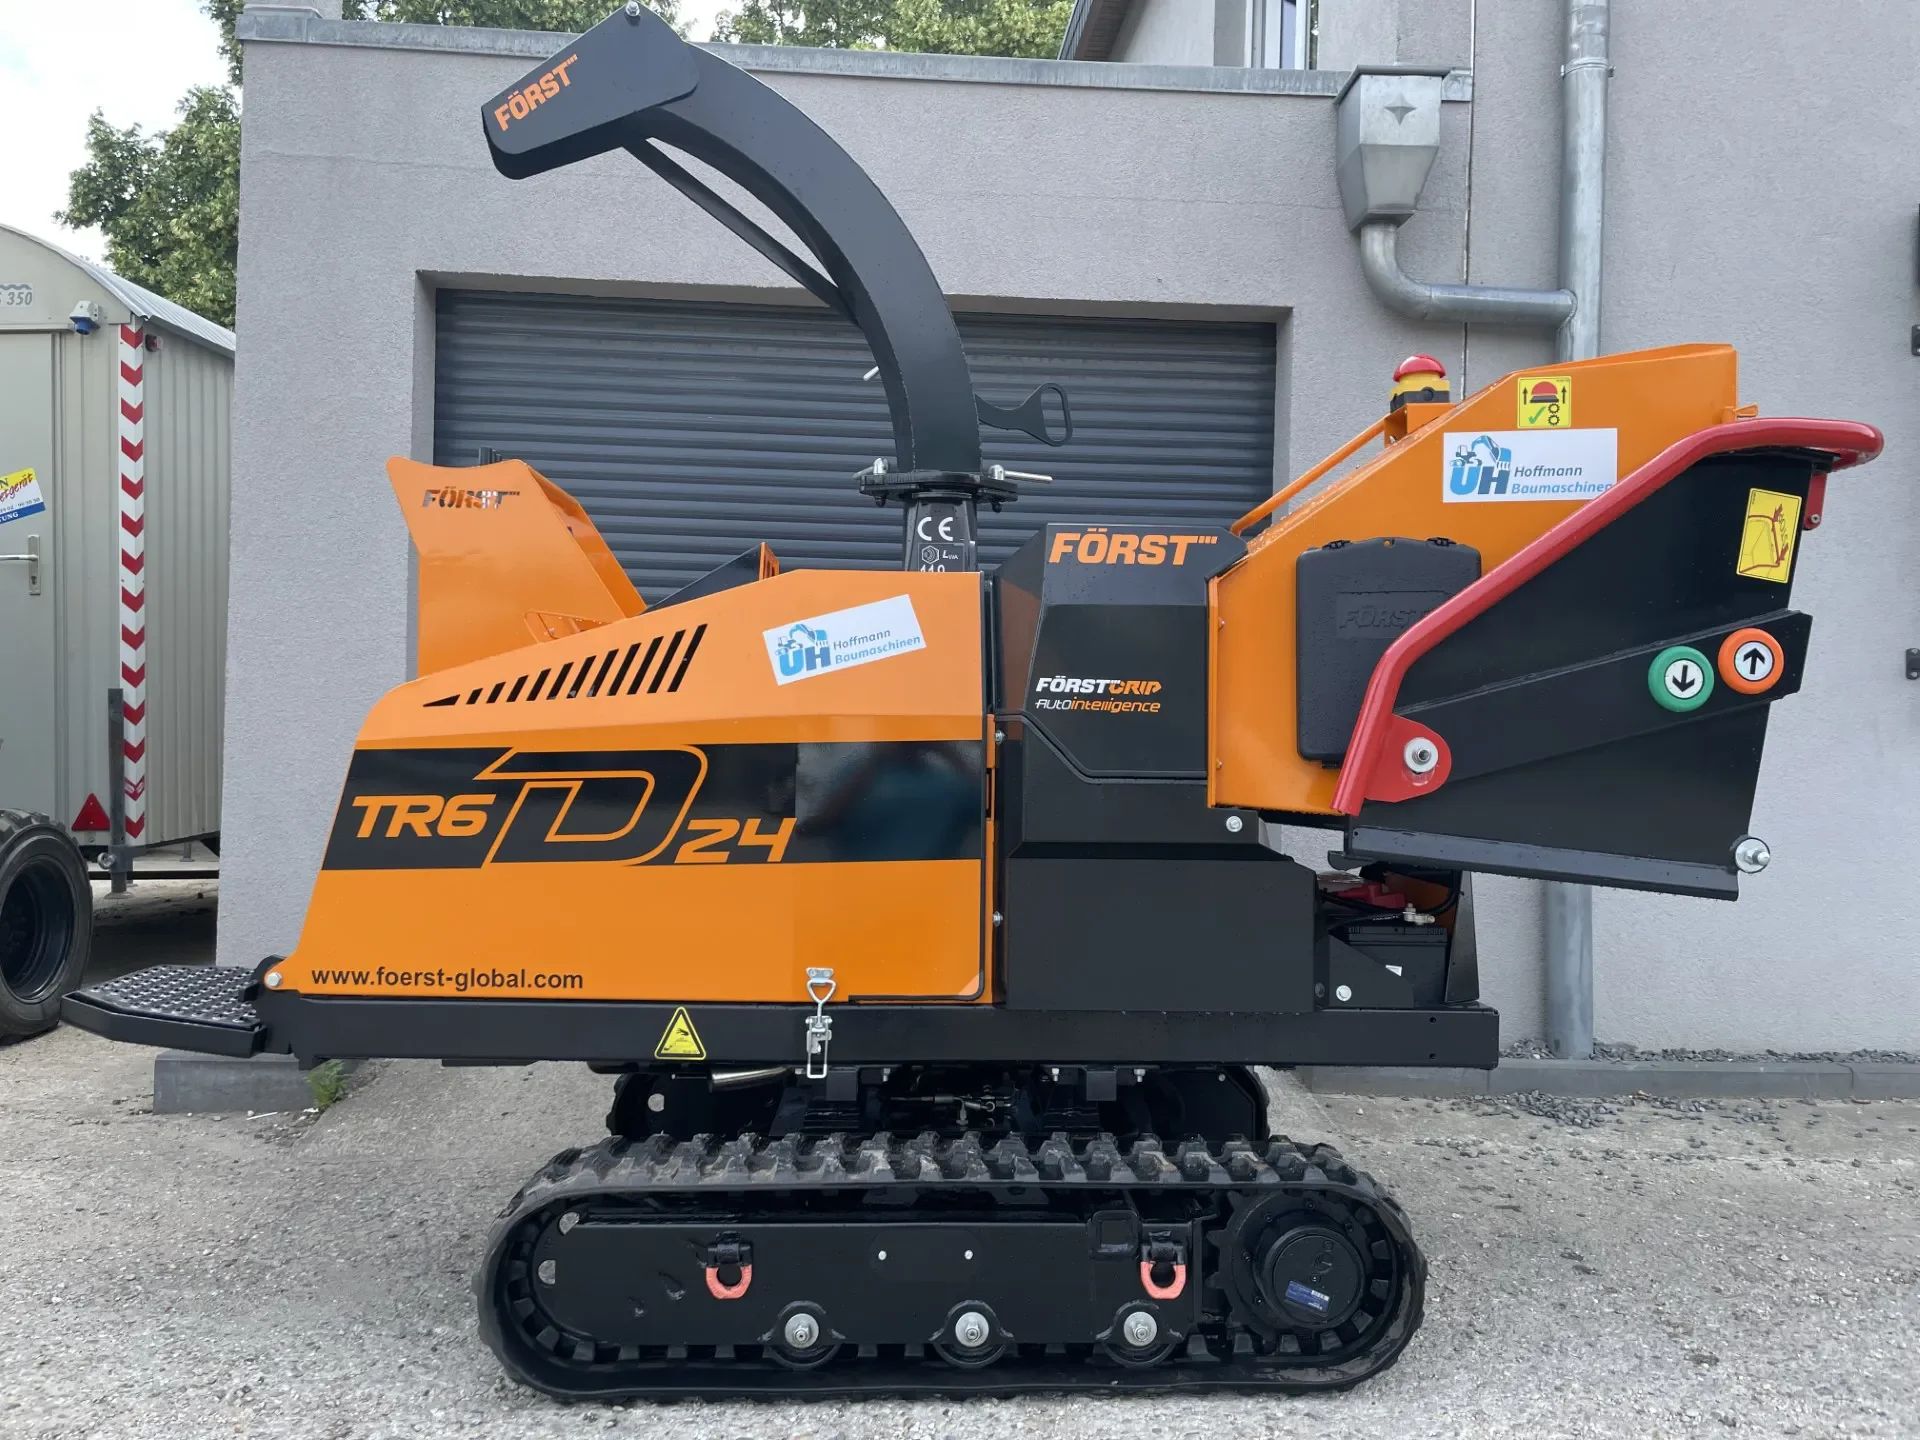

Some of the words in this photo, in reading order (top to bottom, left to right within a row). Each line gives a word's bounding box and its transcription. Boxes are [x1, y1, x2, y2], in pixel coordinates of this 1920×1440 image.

[494, 54, 578, 131] FÖRST
[6, 291, 33, 306] 350
[1514, 465, 1583, 478] Hoffmann
[421, 486, 520, 510] FÖRST
[917, 516, 954, 542] CE
[1047, 527, 1218, 566] FÖRST
[833, 629, 892, 651] Hoffmann
[835, 635, 922, 665] Baumaschinen
[351, 793, 497, 839] TR6
[673, 817, 798, 865] 24
[310, 965, 585, 993] www.foerst-global.com
